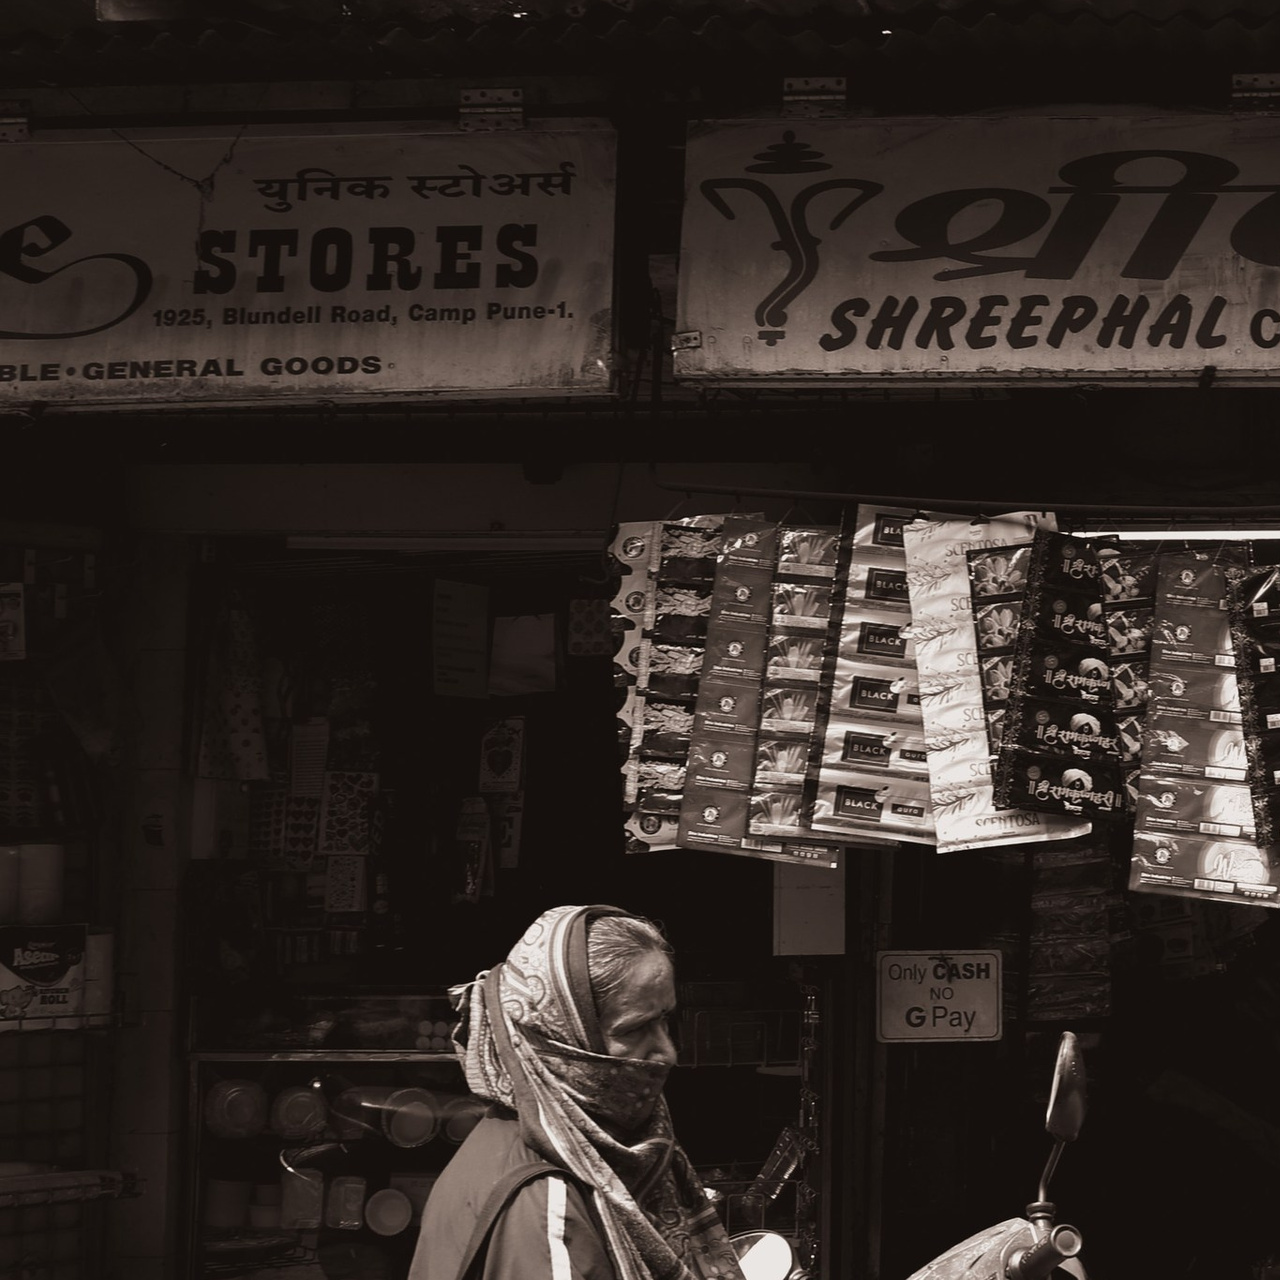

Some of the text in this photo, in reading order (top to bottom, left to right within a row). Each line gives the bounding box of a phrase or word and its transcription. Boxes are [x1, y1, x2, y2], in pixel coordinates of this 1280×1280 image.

[254, 162, 577, 212] युनिक स्टोअर्स
[193, 222, 540, 295] STORES
[152, 302, 574, 329] 1925, Blundell Road, Camp Pune-1.
[819, 294, 1228, 352] SHREEPHAL
[260, 356, 382, 375] GOODS
[876, 580, 908, 592] BLACK
[868, 634, 901, 647] BLACK
[861, 689, 894, 701] BLACK
[853, 744, 886, 756] BLACK
[844, 798, 878, 811] BLACK
[888, 962, 990, 984] Only CASH
[930, 987, 954, 1000] NO
[905, 1006, 976, 1032] G Pay
